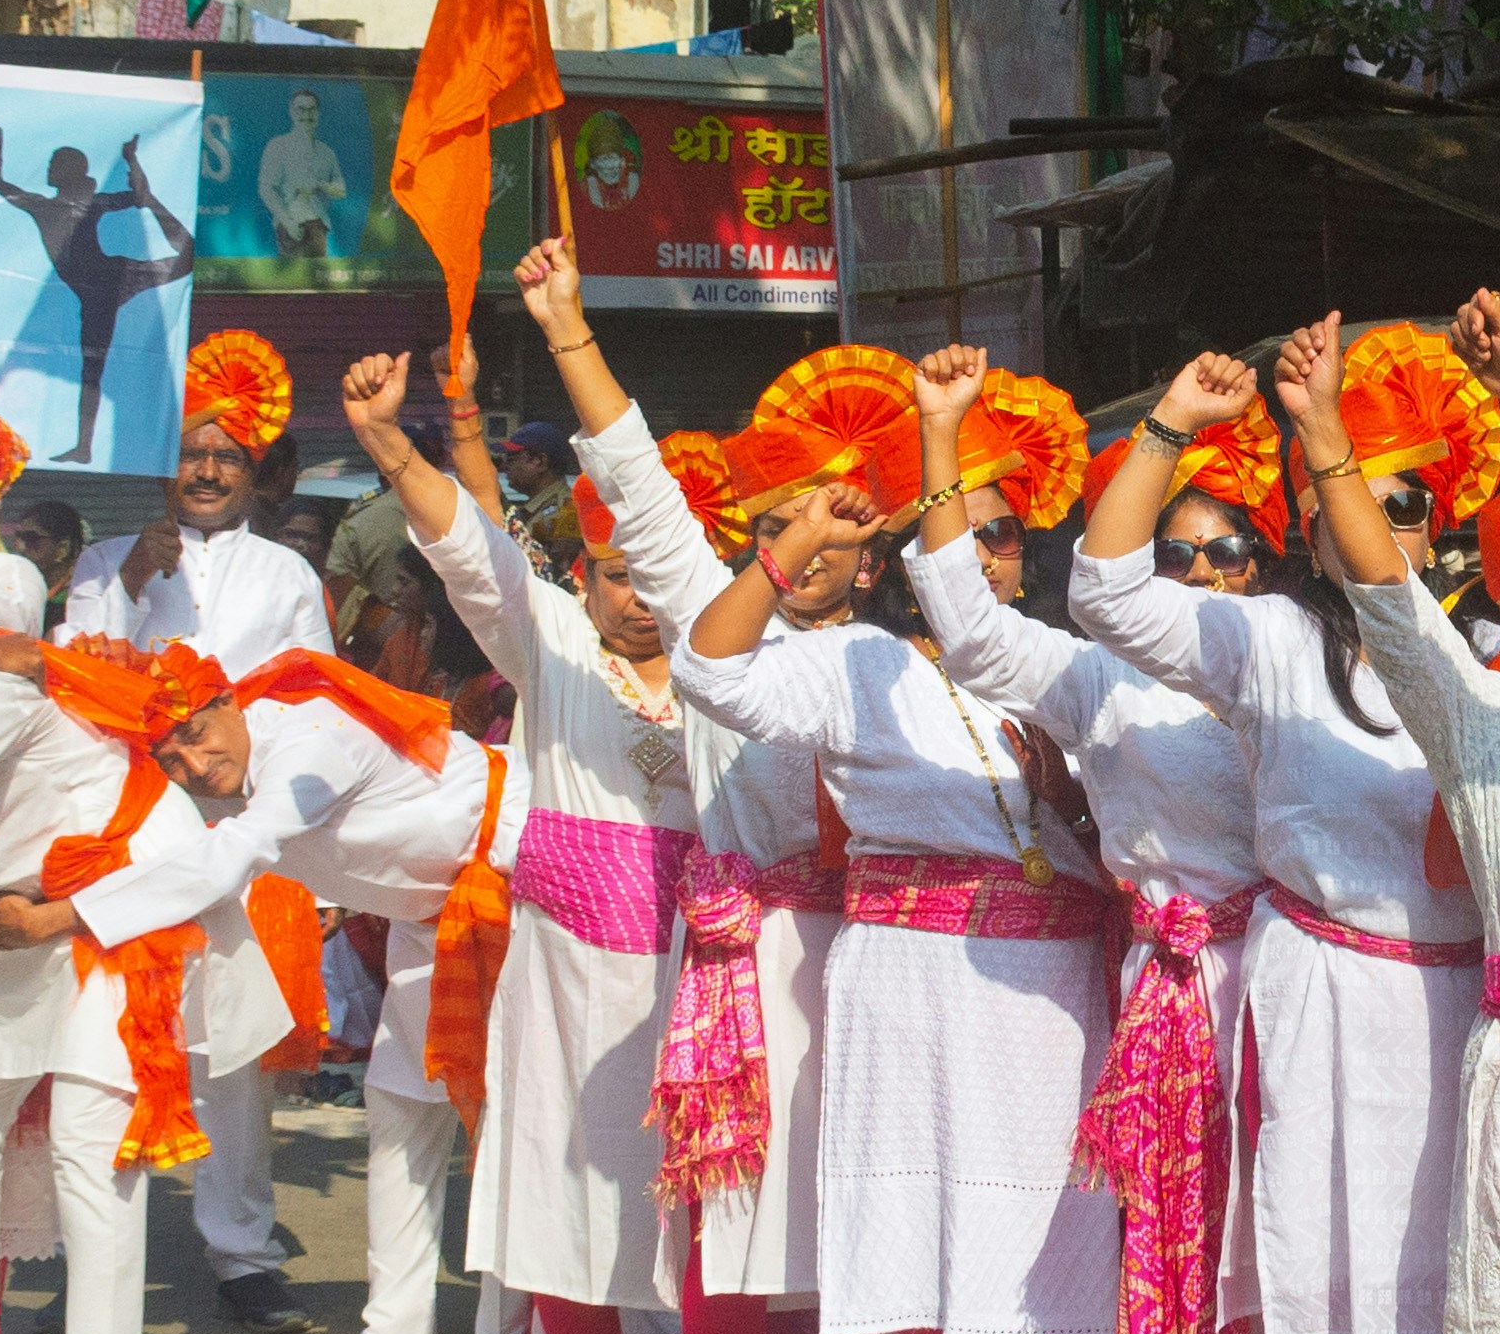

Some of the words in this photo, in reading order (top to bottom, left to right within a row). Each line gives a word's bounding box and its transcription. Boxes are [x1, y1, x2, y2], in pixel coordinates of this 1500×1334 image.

[668, 115, 734, 164] श्री
[656, 241, 721, 269] SHRI
[729, 243, 774, 271] SAI
[691, 283, 719, 303] All
[724, 283, 839, 305] Condiments
